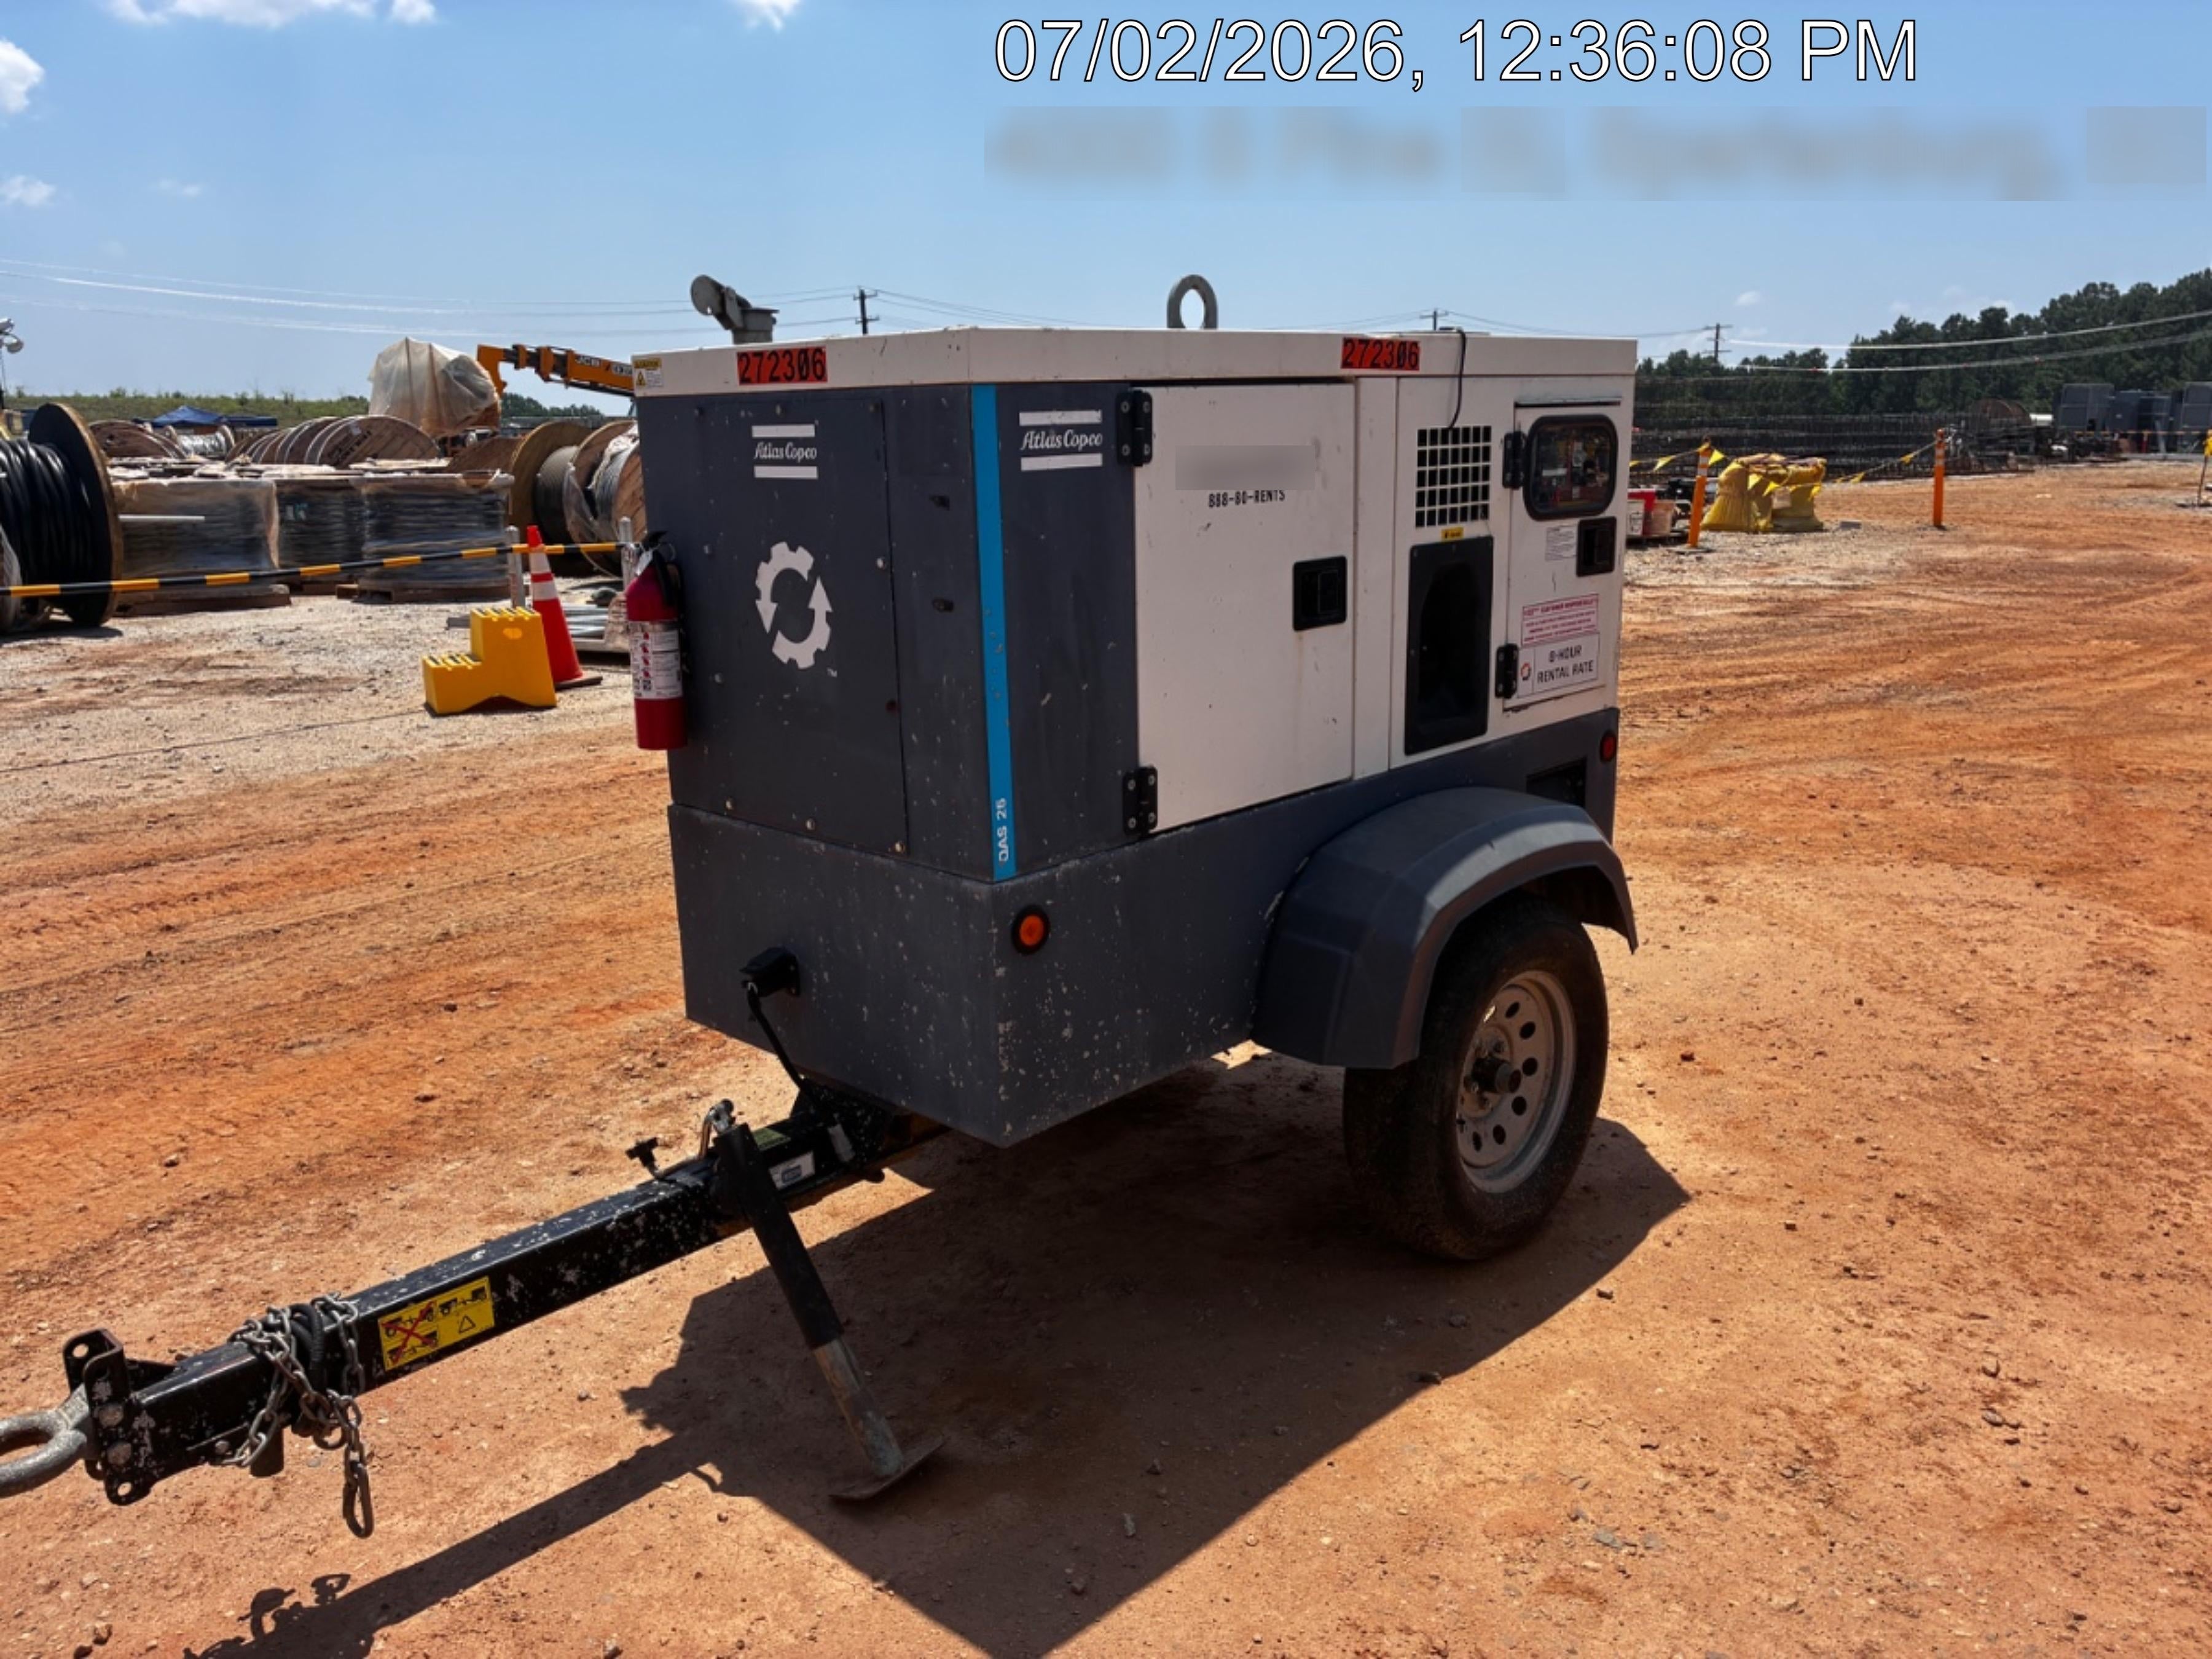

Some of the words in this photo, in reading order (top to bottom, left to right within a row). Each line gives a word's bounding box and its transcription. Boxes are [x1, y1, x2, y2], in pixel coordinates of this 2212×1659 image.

[738, 348, 825, 384] 272306
[1342, 338, 1419, 369] 272306
[753, 441, 784, 460] Atlas
[785, 441, 817, 463] Copco
[1020, 431, 1062, 450] Atlas
[1064, 429, 1103, 452] Copco
[1537, 666, 1569, 684] RENTAL
[1572, 659, 1593, 675] RATE
